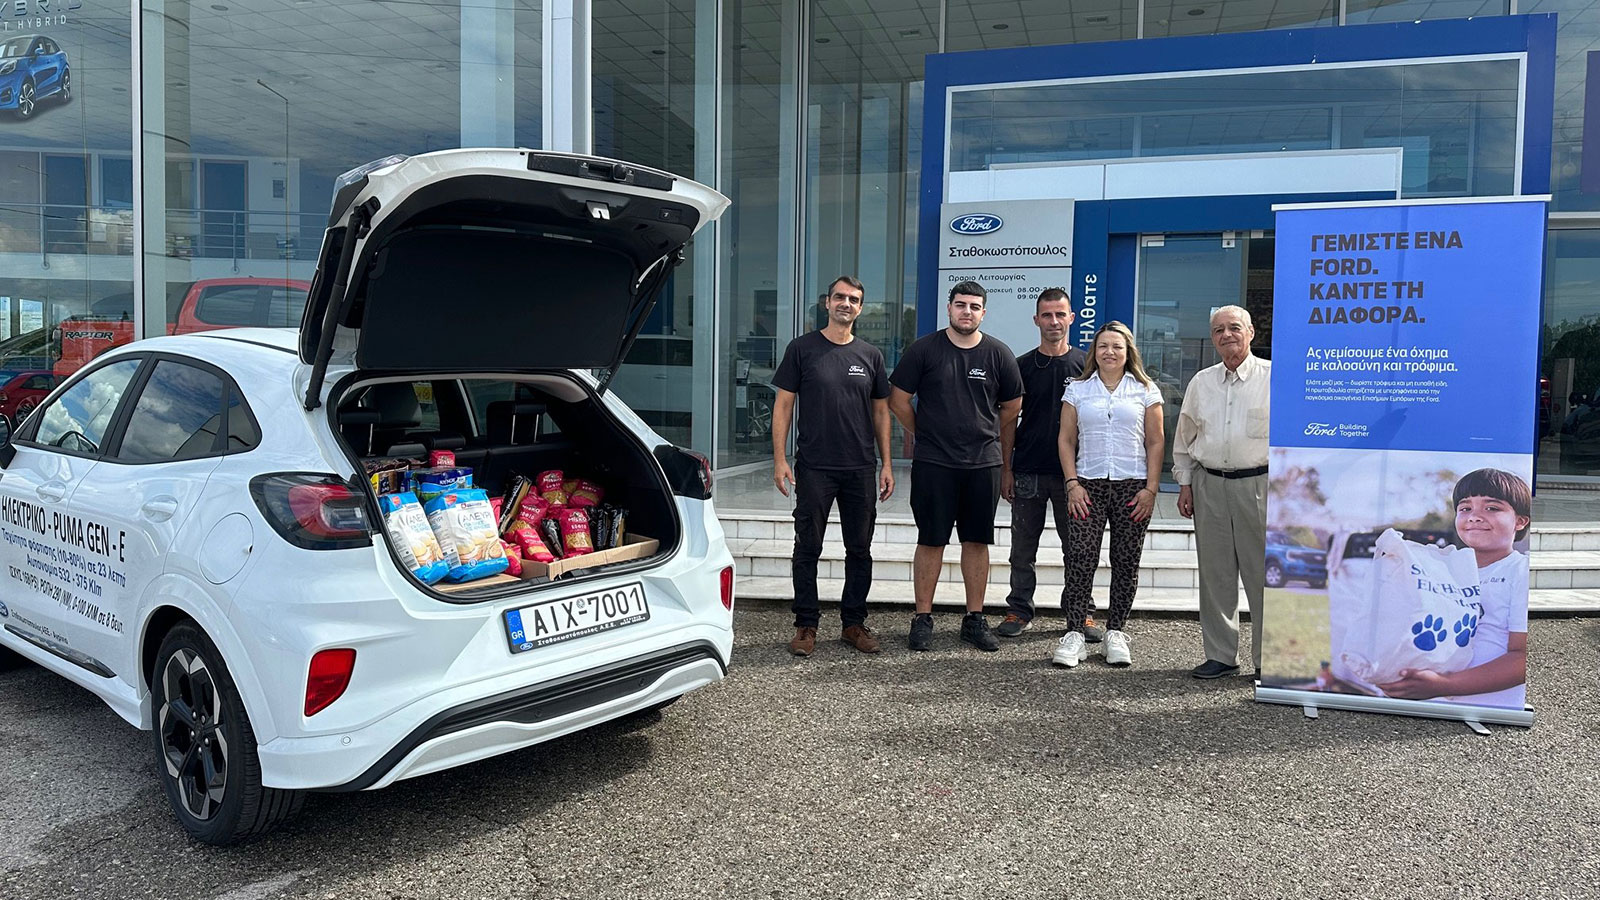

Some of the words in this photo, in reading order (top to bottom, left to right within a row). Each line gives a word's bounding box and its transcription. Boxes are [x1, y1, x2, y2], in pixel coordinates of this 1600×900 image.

[17, 15, 67, 29] HYBRID
[960, 217, 992, 231] Ford
[1311, 232, 1409, 252] ΓΕΜΙΣΤΕ
[1414, 231, 1463, 249] ΕΝΑ
[949, 244, 1067, 258] Σταθοκωστόπουλος
[1310, 258, 1379, 276] FORD.
[978, 273, 1026, 282] Λειτουργίας
[1309, 282, 1387, 300] ΚΑΝΤΕ
[1392, 281, 1424, 298] ΤΗ
[1308, 306, 1425, 324] ΔΙΑΦΟΡΑ.
[65, 331, 114, 342] RAPTOR
[1306, 347, 1321, 359] Ας
[1324, 346, 1384, 360] γεμίσουμε
[1386, 346, 1408, 358] ένα
[1410, 346, 1449, 360] όχημα
[849, 365, 864, 373] Ford
[969, 368, 986, 376] Ford
[1306, 362, 1320, 373] με
[1322, 360, 1380, 373] καλοσύνη
[1383, 362, 1401, 371] και
[1404, 360, 1458, 373] τρόφιμα.
[1304, 422, 1338, 436] Ford
[462, 511, 492, 522] ΑΛΕΥΡΙ
[2, 495, 46, 535] ΗΛΕΚΤΡΙΚΟ
[53, 511, 86, 549] PUMA
[87, 521, 110, 557] GEN
[87, 561, 97, 574] σε
[97, 562, 107, 578] 23
[511, 631, 524, 640] GR
